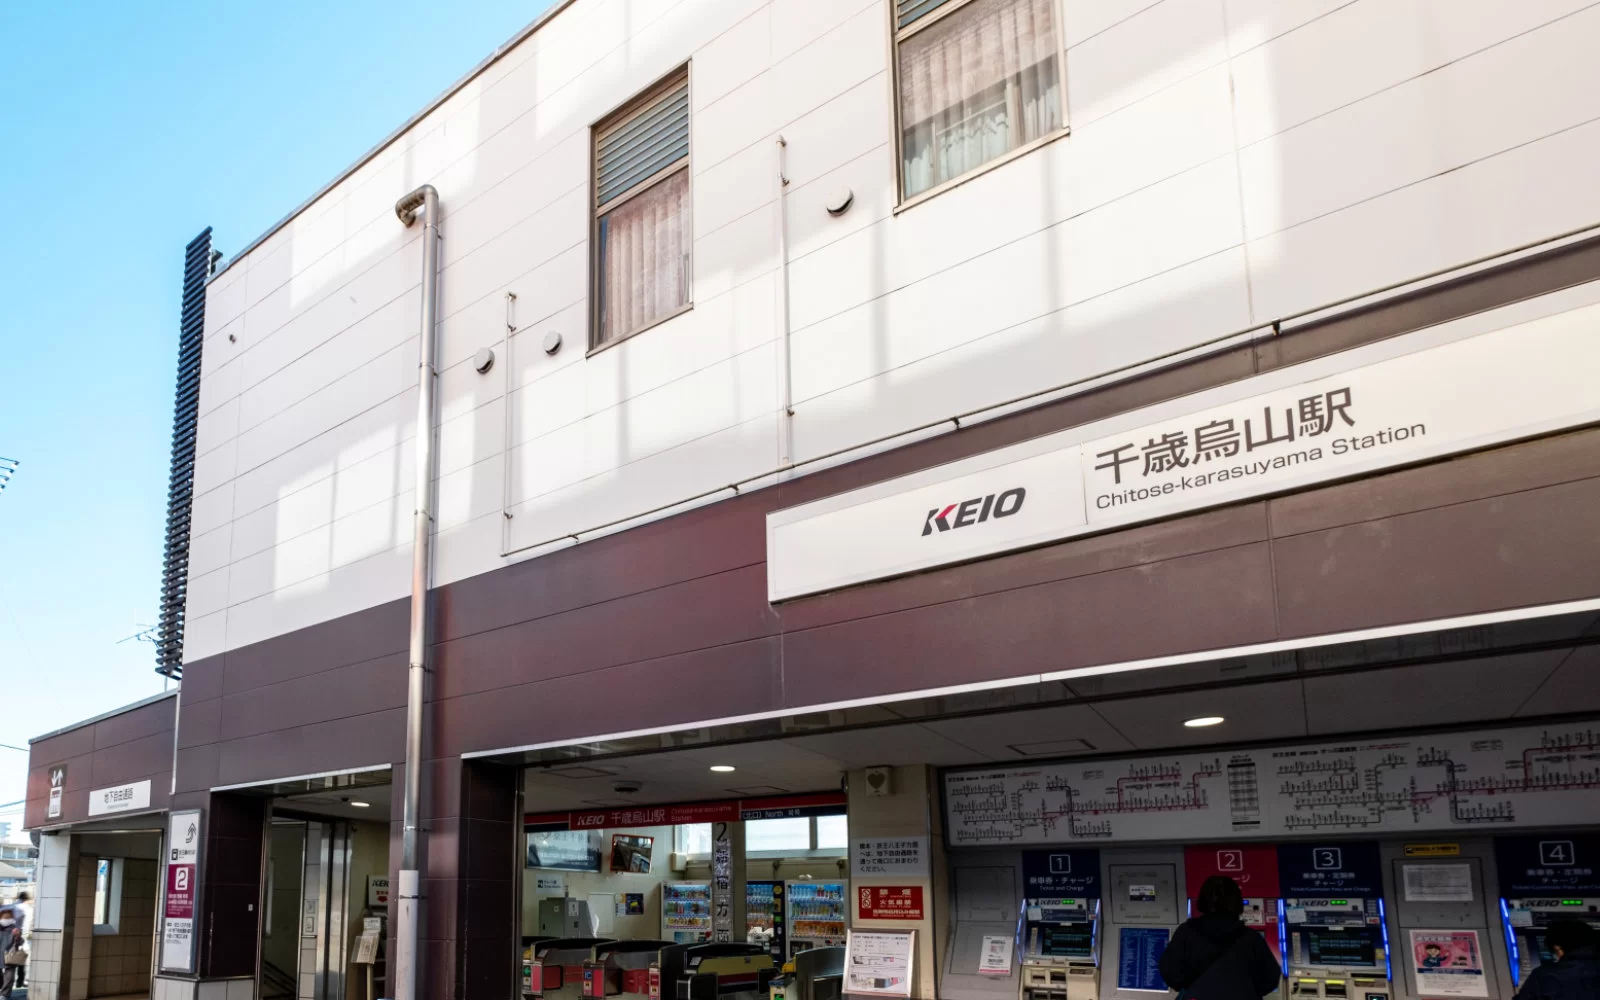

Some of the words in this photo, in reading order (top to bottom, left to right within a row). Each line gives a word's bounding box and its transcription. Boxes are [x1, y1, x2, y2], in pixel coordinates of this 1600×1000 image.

[1094, 387, 1355, 484] 千歳烏山駅
[1096, 445, 1323, 509] Chitose-karasuyama
[1332, 423, 1426, 455] Station
[921, 487, 1026, 536] KEIO
[577, 814, 606, 826] KEIO
[610, 809, 665, 825] 千歳烏山駅
[1224, 853, 1237, 867] 2
[1321, 851, 1335, 866] 3
[1548, 844, 1567, 861] 4
[177, 870, 187, 888] 2
[1029, 876, 1094, 885] 乗車券・チャージ
